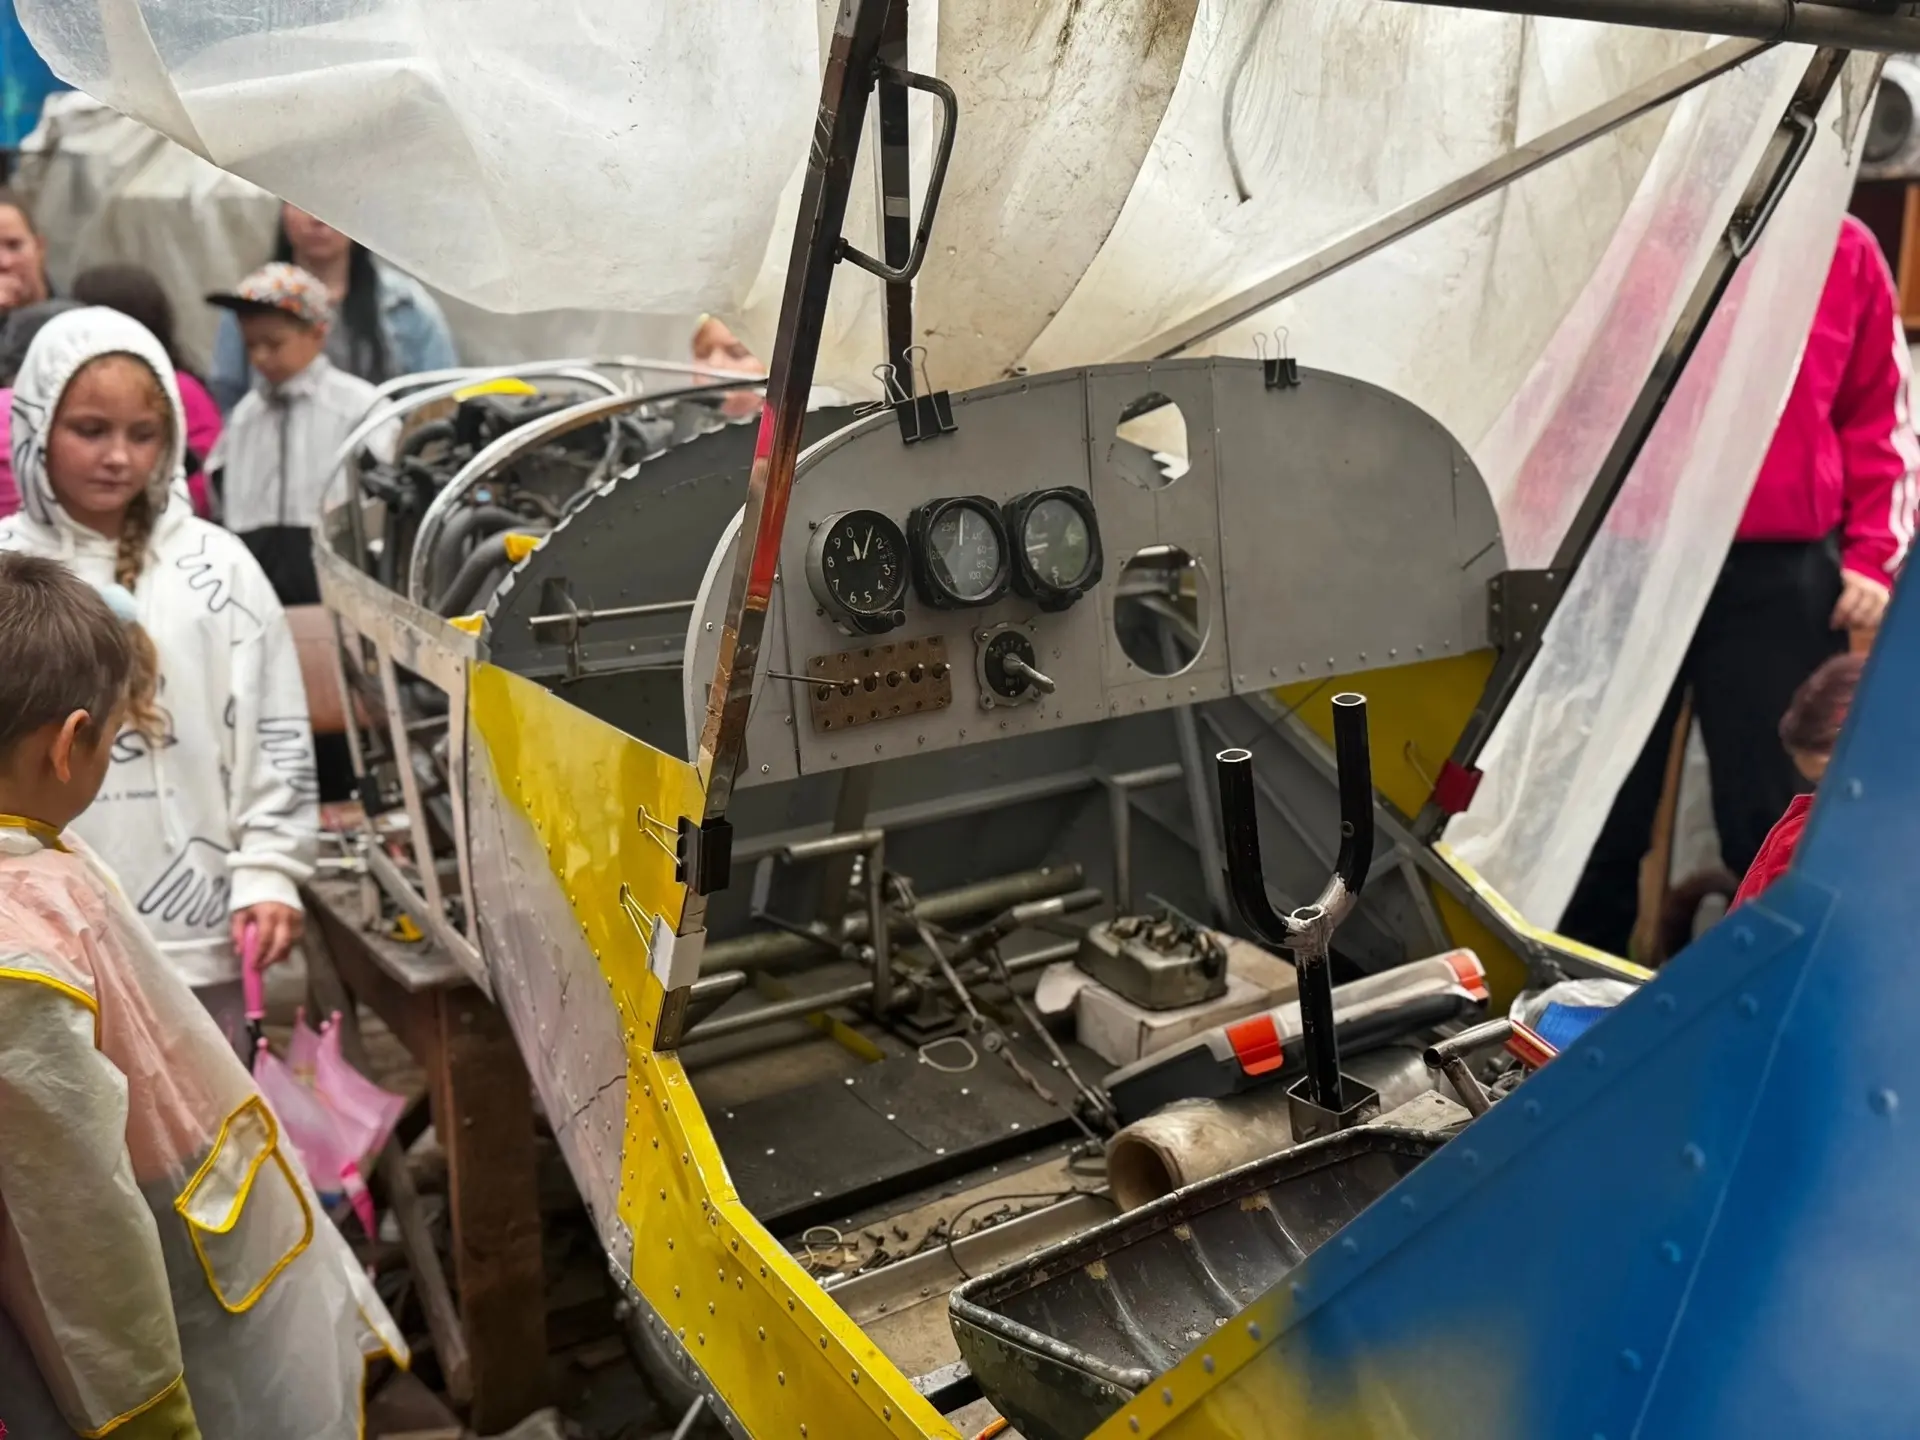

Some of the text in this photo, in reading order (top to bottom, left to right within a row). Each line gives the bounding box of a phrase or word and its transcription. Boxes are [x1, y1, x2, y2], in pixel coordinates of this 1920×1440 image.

[846, 526, 854, 538] 0
[941, 521, 955, 532] 250
[834, 537, 842, 550] 9
[876, 537, 885, 550] 2
[976, 544, 987, 555] 60
[827, 556, 836, 568] 8
[976, 560, 987, 569] 80
[882, 564, 891, 576] 3
[968, 571, 982, 581] 100
[1051, 566, 1060, 579] 5
[833, 578, 840, 591] 7
[877, 580, 885, 591] 4
[850, 591, 858, 604] 6
[864, 590, 873, 604] 5
